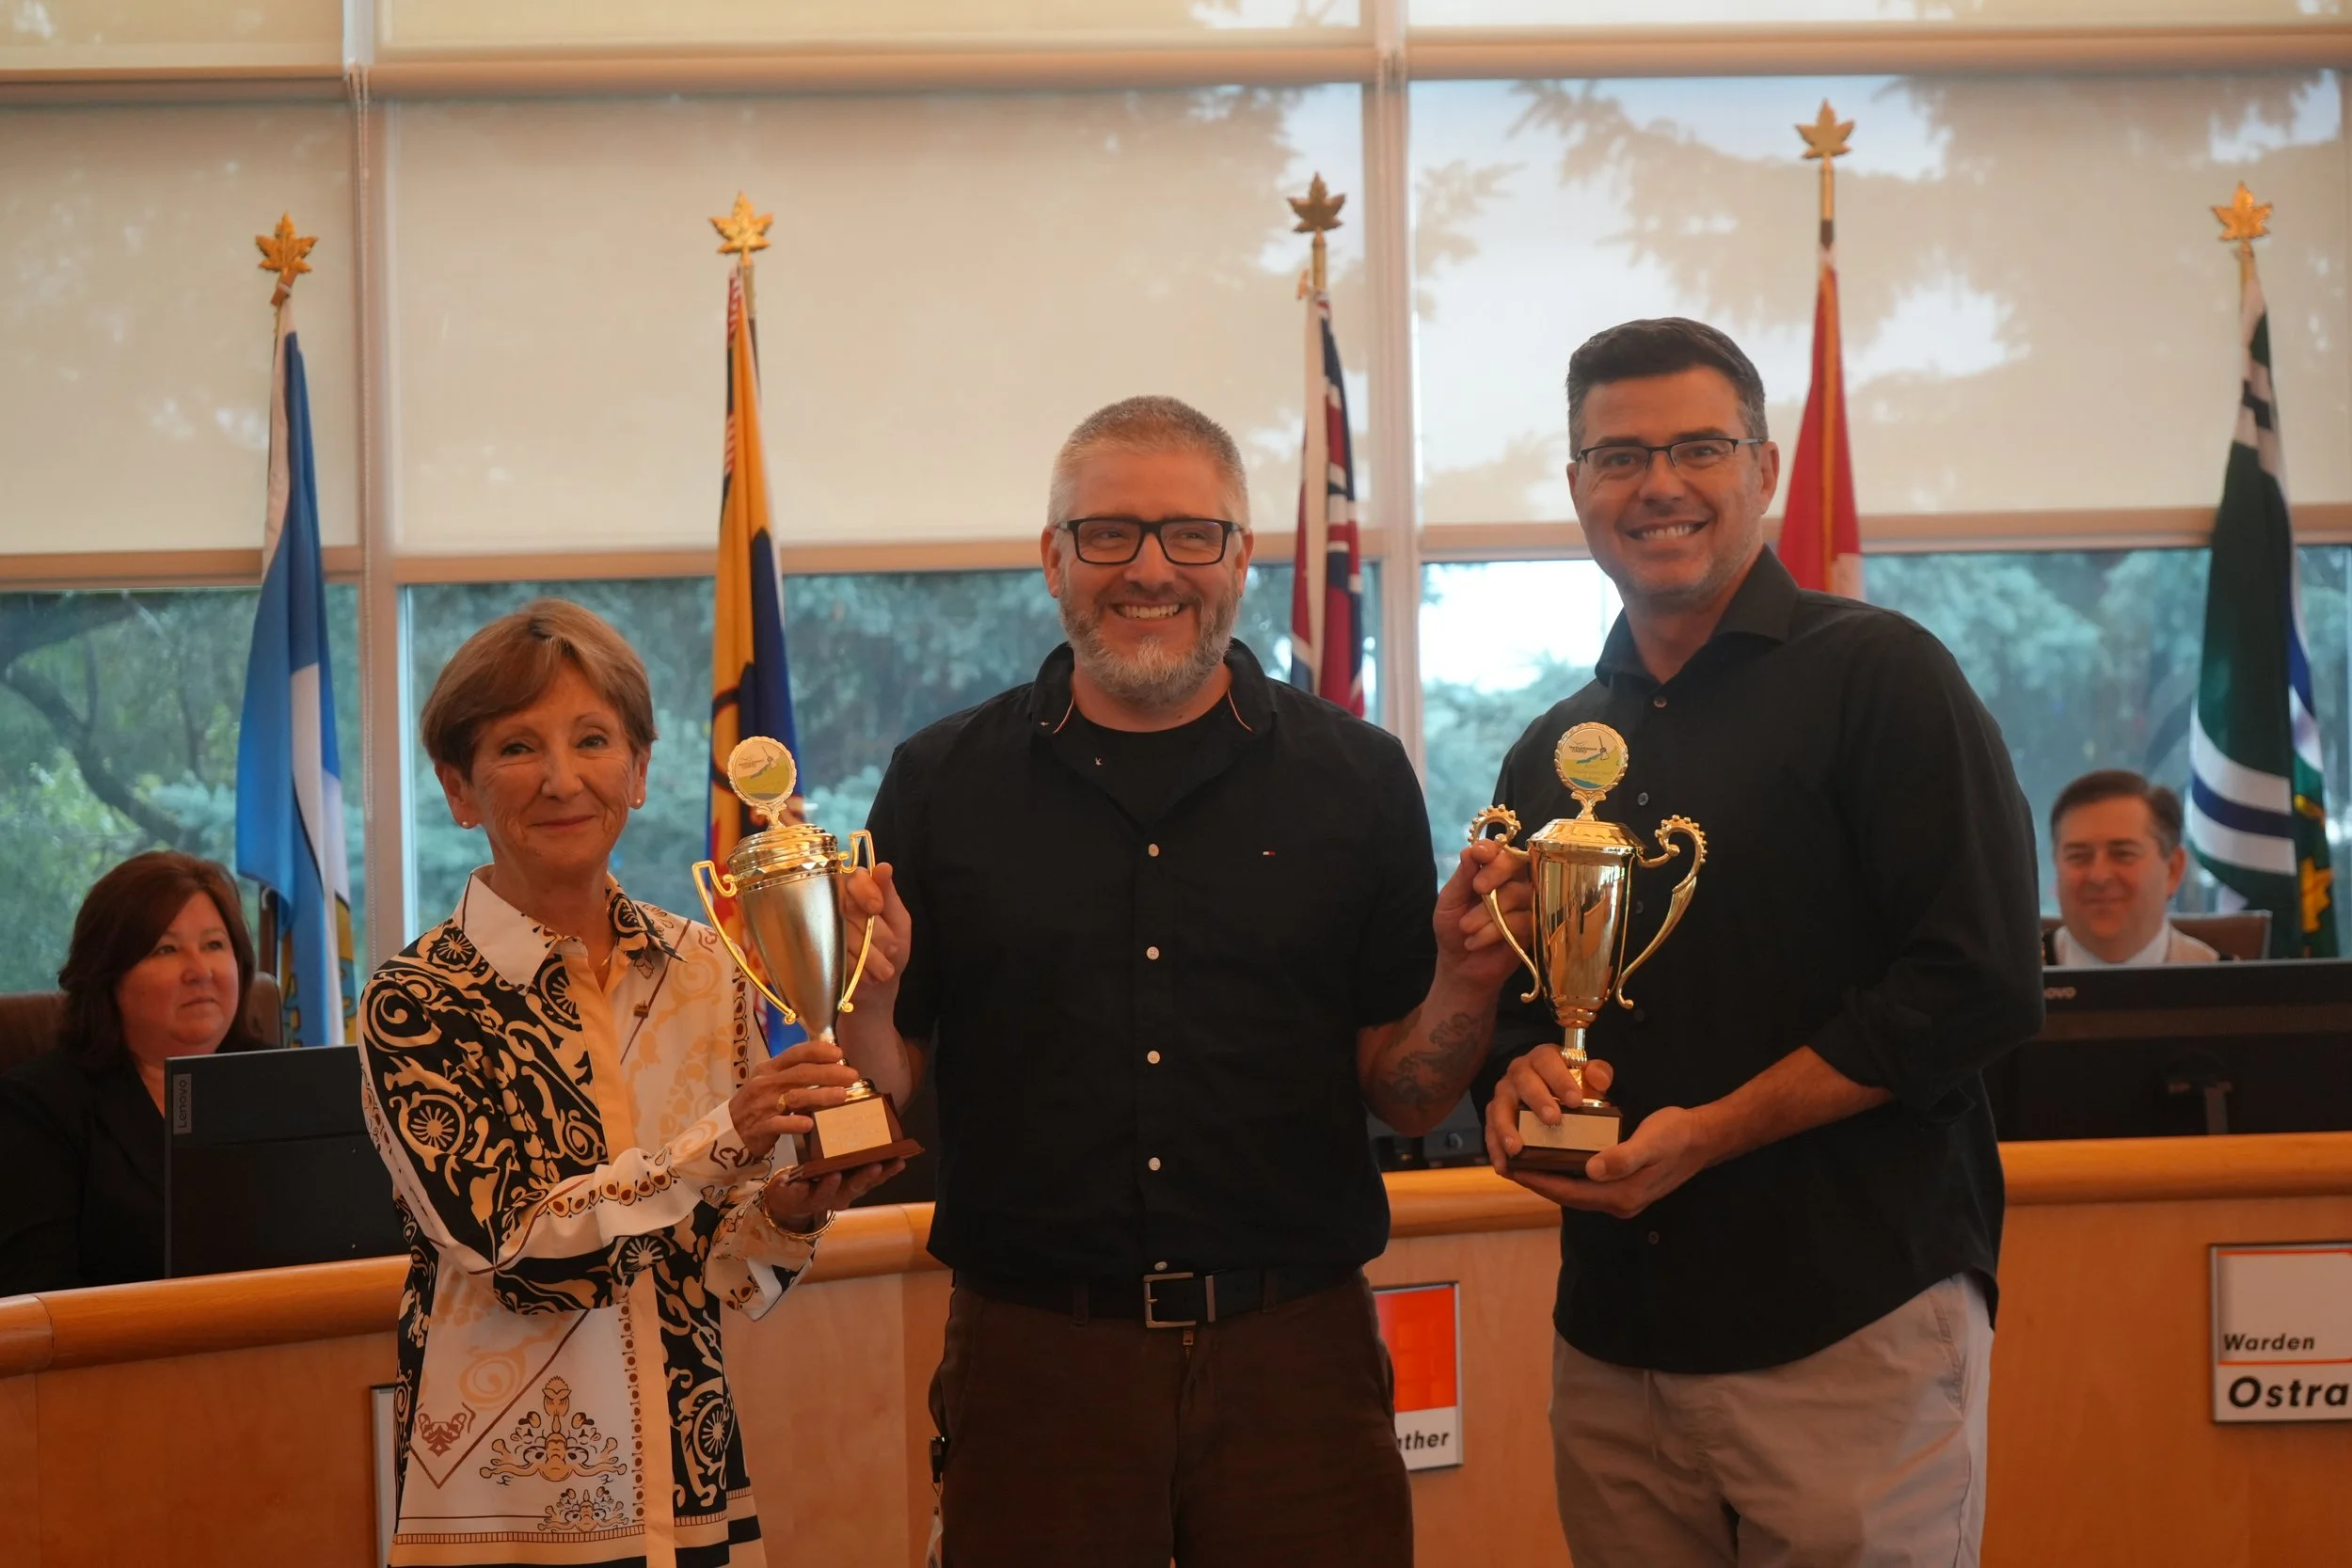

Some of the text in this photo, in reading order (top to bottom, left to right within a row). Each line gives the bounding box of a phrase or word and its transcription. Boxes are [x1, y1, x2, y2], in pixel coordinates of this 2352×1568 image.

[2043, 986, 2077, 1000] ovo
[177, 1079, 188, 1129] Lenovo
[2223, 1333, 2315, 1352] Warden
[2228, 1375, 2350, 1409] Ostra
